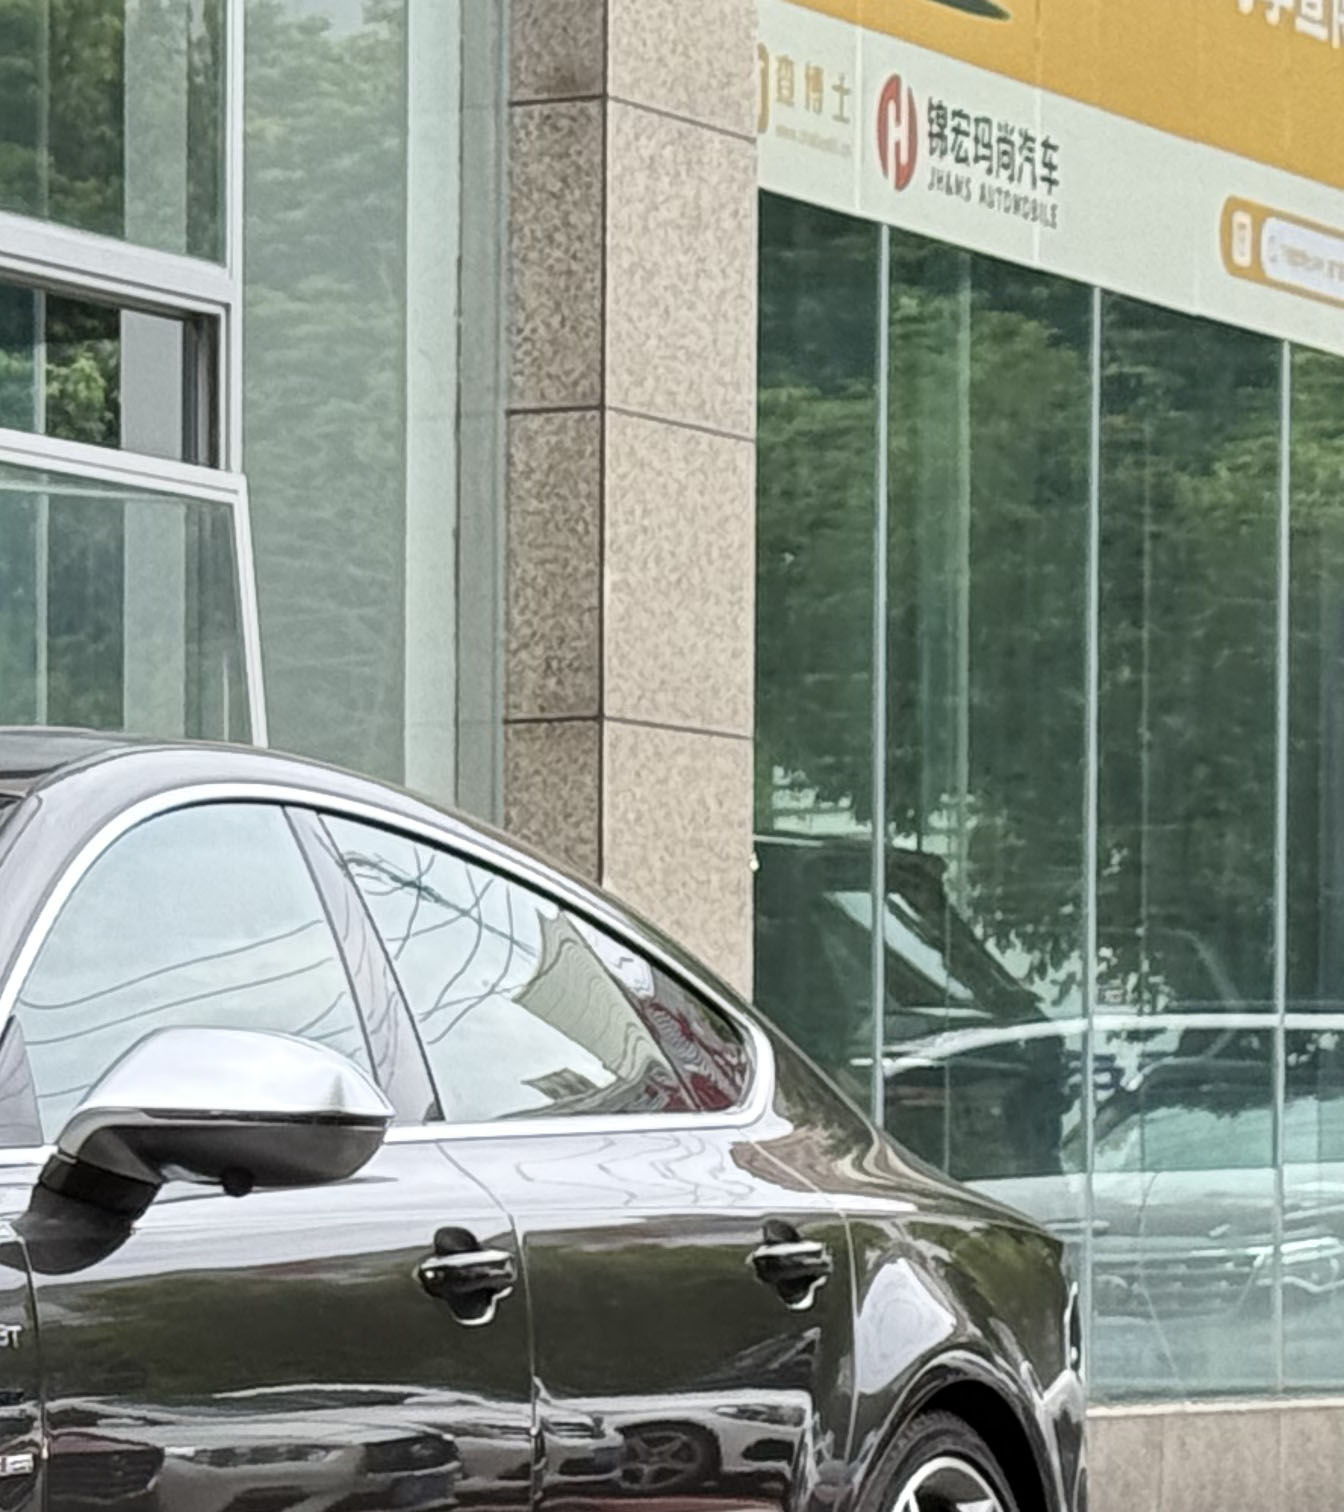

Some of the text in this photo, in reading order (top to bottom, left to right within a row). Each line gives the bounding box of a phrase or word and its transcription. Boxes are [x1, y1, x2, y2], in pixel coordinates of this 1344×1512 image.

[927, 96, 1060, 195] 锦宏玛尚汽车
[979, 182, 1059, 230] AUTOMOBILE
